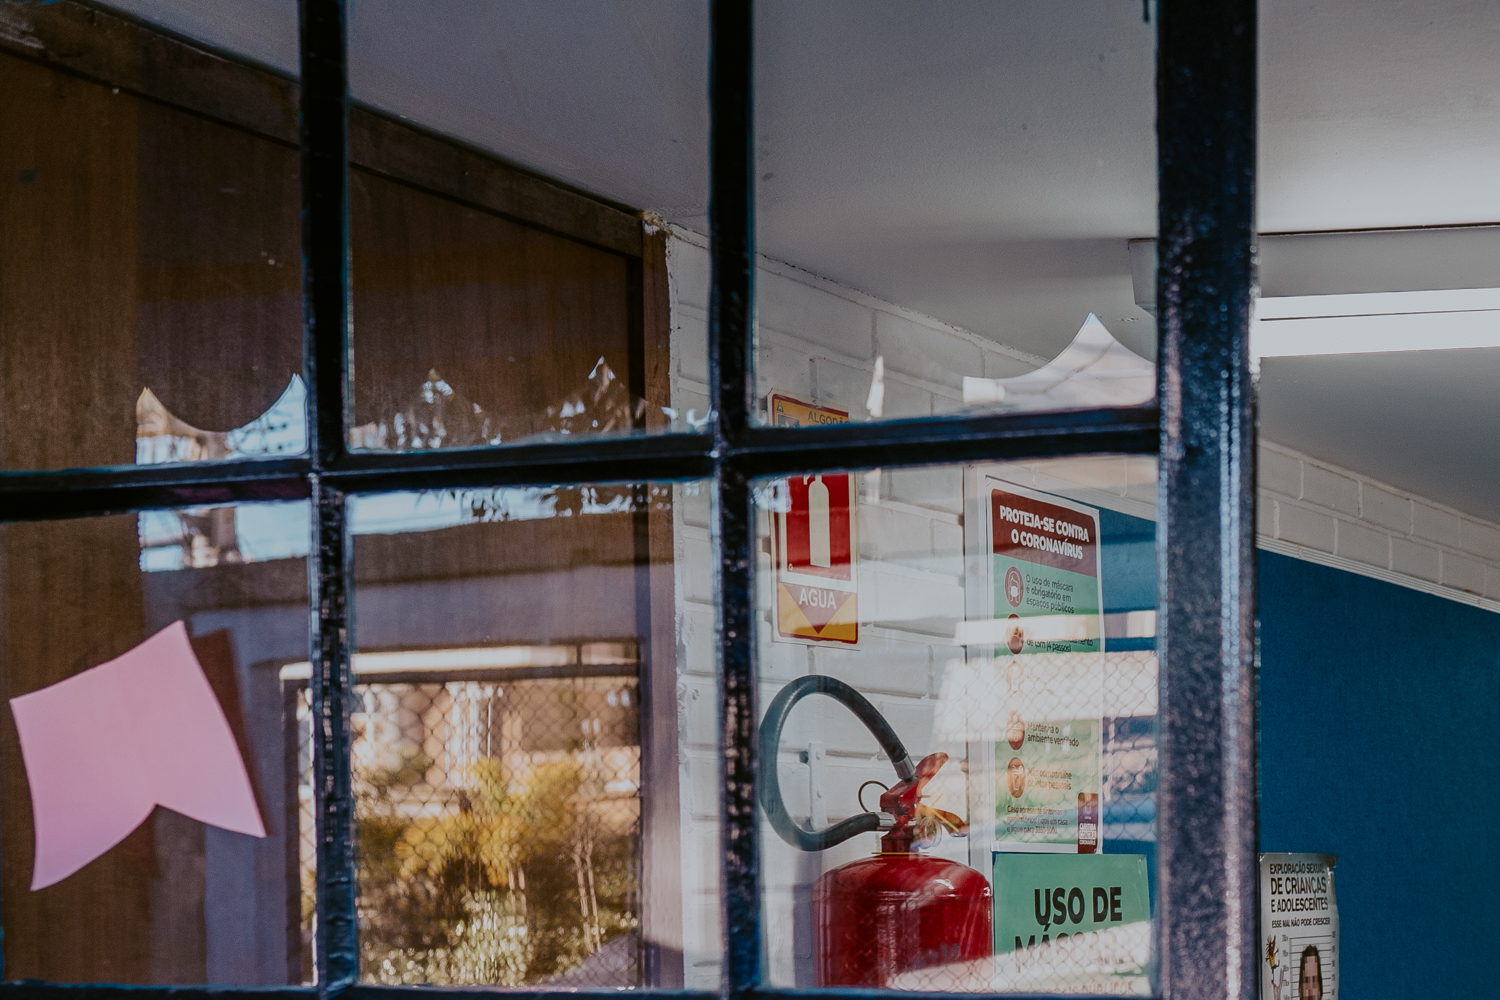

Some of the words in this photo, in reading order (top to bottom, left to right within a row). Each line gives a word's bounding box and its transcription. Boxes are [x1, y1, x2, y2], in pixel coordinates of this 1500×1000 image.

[807, 411, 850, 425] ALGODÃ
[999, 505, 1054, 533] PROTEJA-SE
[1055, 520, 1089, 543] CONTRA
[1011, 528, 1019, 544] O
[1020, 531, 1083, 560] CORONAVÍRUS
[1025, 573, 1031, 583] O
[1032, 575, 1042, 586] uso
[1043, 577, 1051, 587] de
[1052, 580, 1074, 593] máscara
[1031, 585, 1061, 600] obrigatório
[1062, 593, 1072, 603] em
[1026, 597, 1050, 611] espaços
[1050, 600, 1075, 614] públicos
[1027, 732, 1053, 745] ambiente
[1269, 861, 1306, 876] EXPLORAÇÃO
[1306, 863, 1326, 874] SEXUAL
[1270, 876, 1284, 896] DE
[1284, 875, 1327, 899] CRIANÇAS
[1034, 887, 1085, 926] USO
[1092, 886, 1123, 923] DE
[1271, 898, 1276, 913] E
[1276, 896, 1329, 913] ADOLESCENTES
[1271, 919, 1282, 929] ESSE
[1291, 916, 1300, 928] NÃO
[1301, 917, 1312, 927] PODE
[1312, 916, 1331, 926] CRESCER
